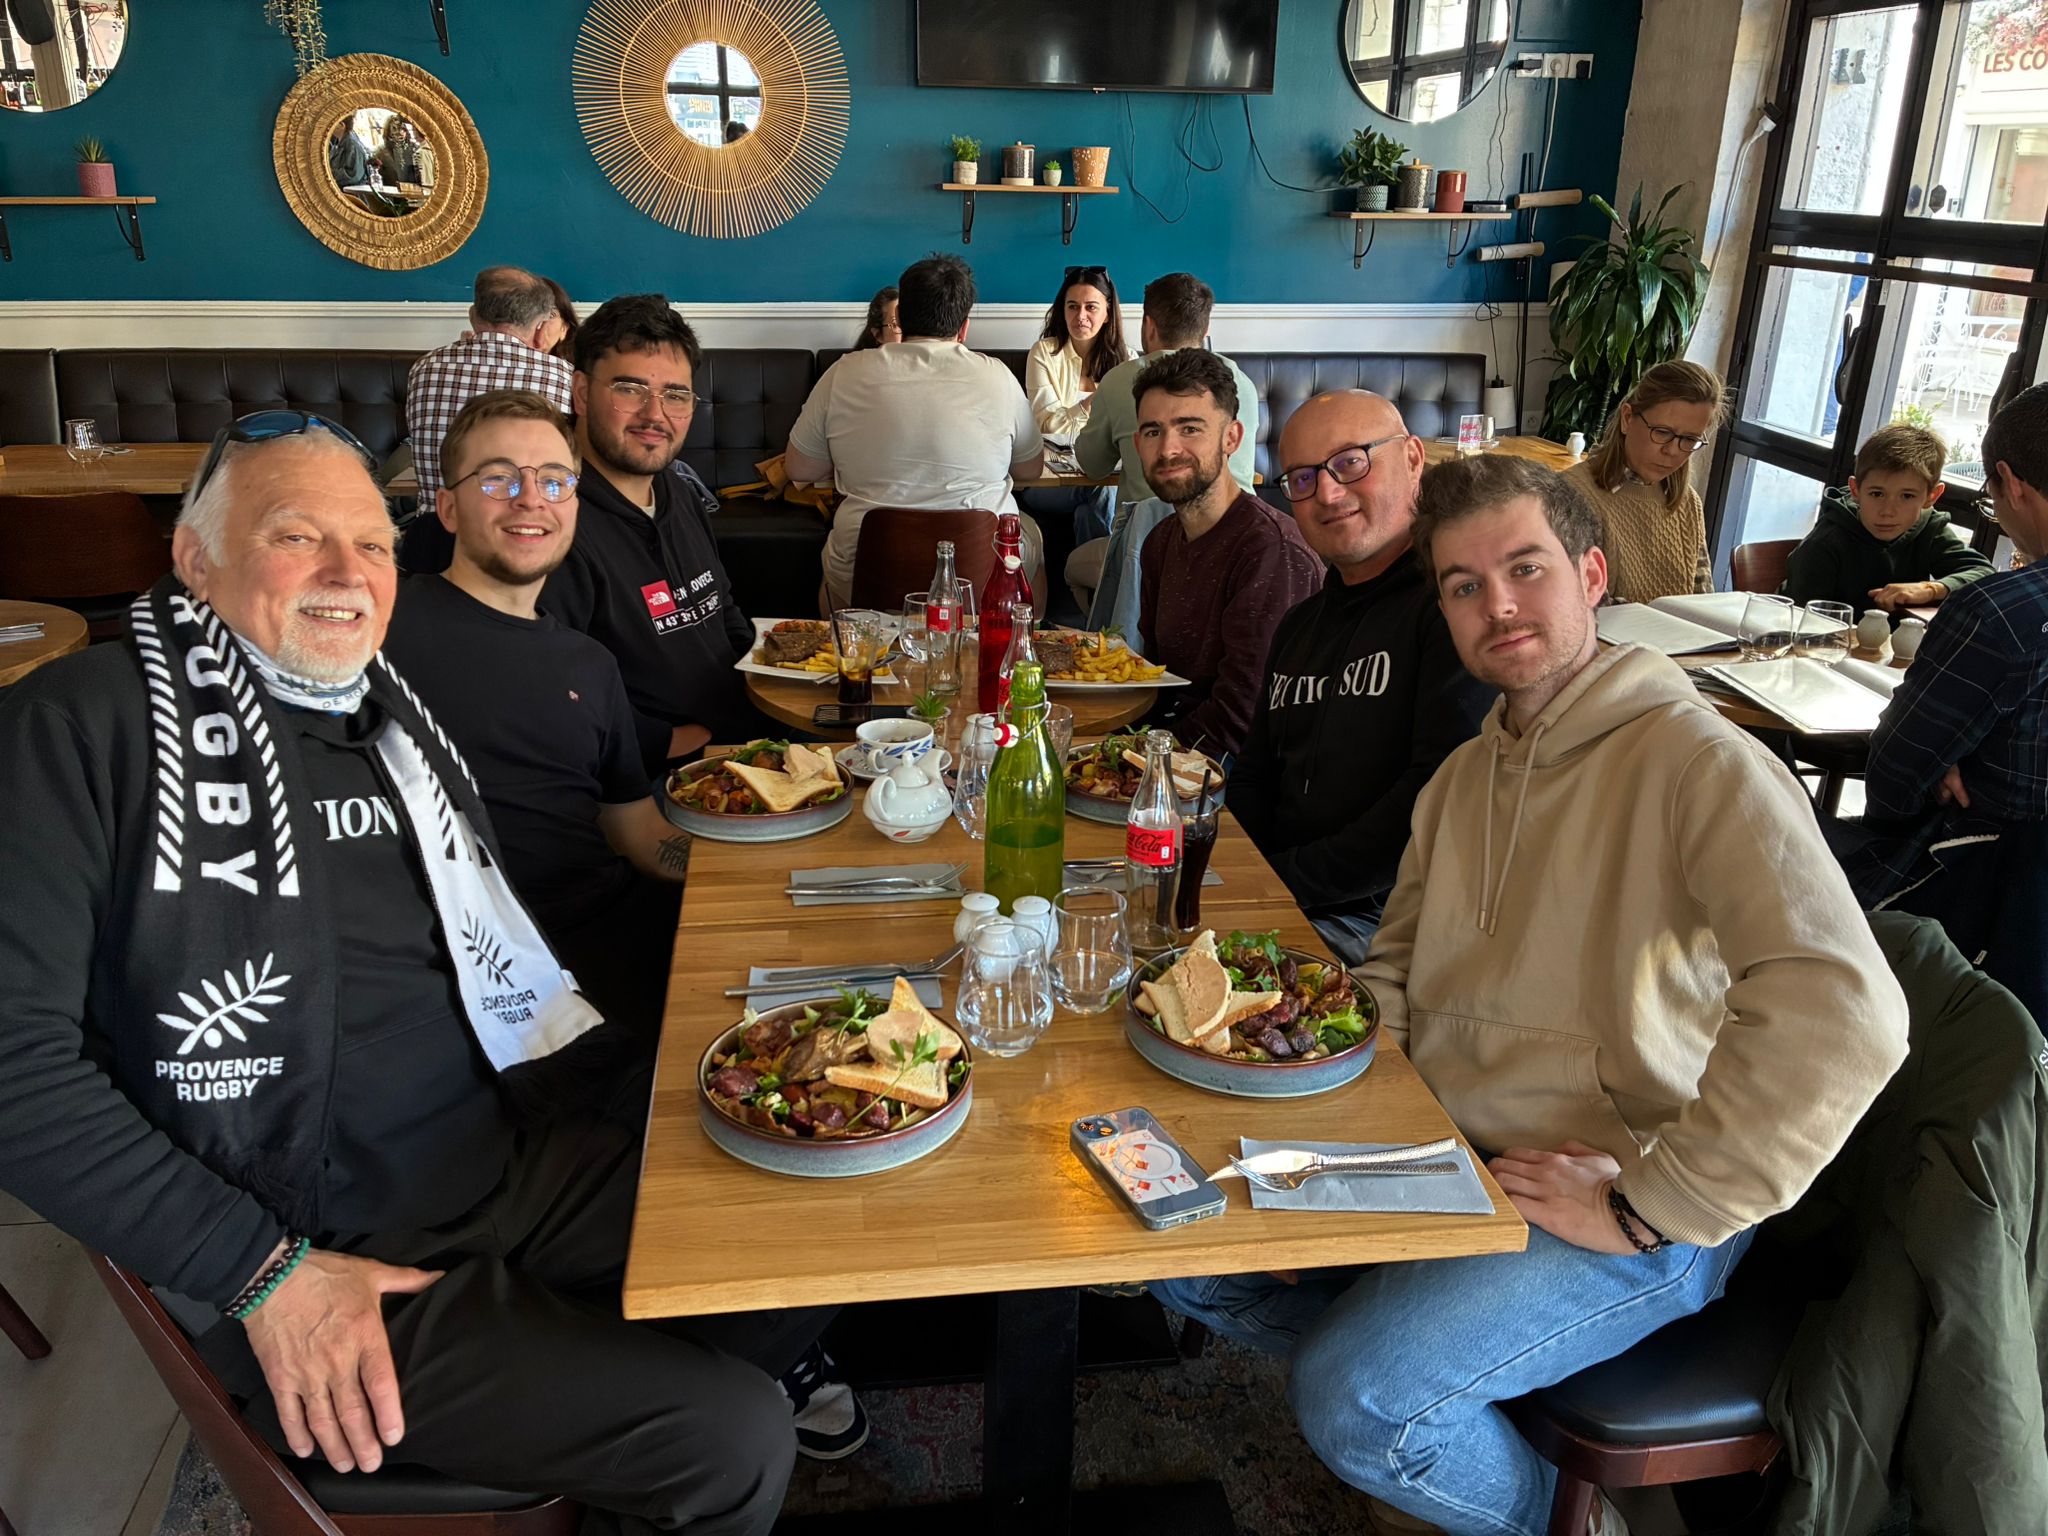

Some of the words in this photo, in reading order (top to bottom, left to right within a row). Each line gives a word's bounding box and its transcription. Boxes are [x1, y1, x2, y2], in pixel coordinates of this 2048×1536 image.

[1983, 53, 2015, 73] LES
[1338, 651, 1391, 696] SUD
[155, 1057, 284, 1080] PROVENCE
[176, 1078, 259, 1102] RUGBY
